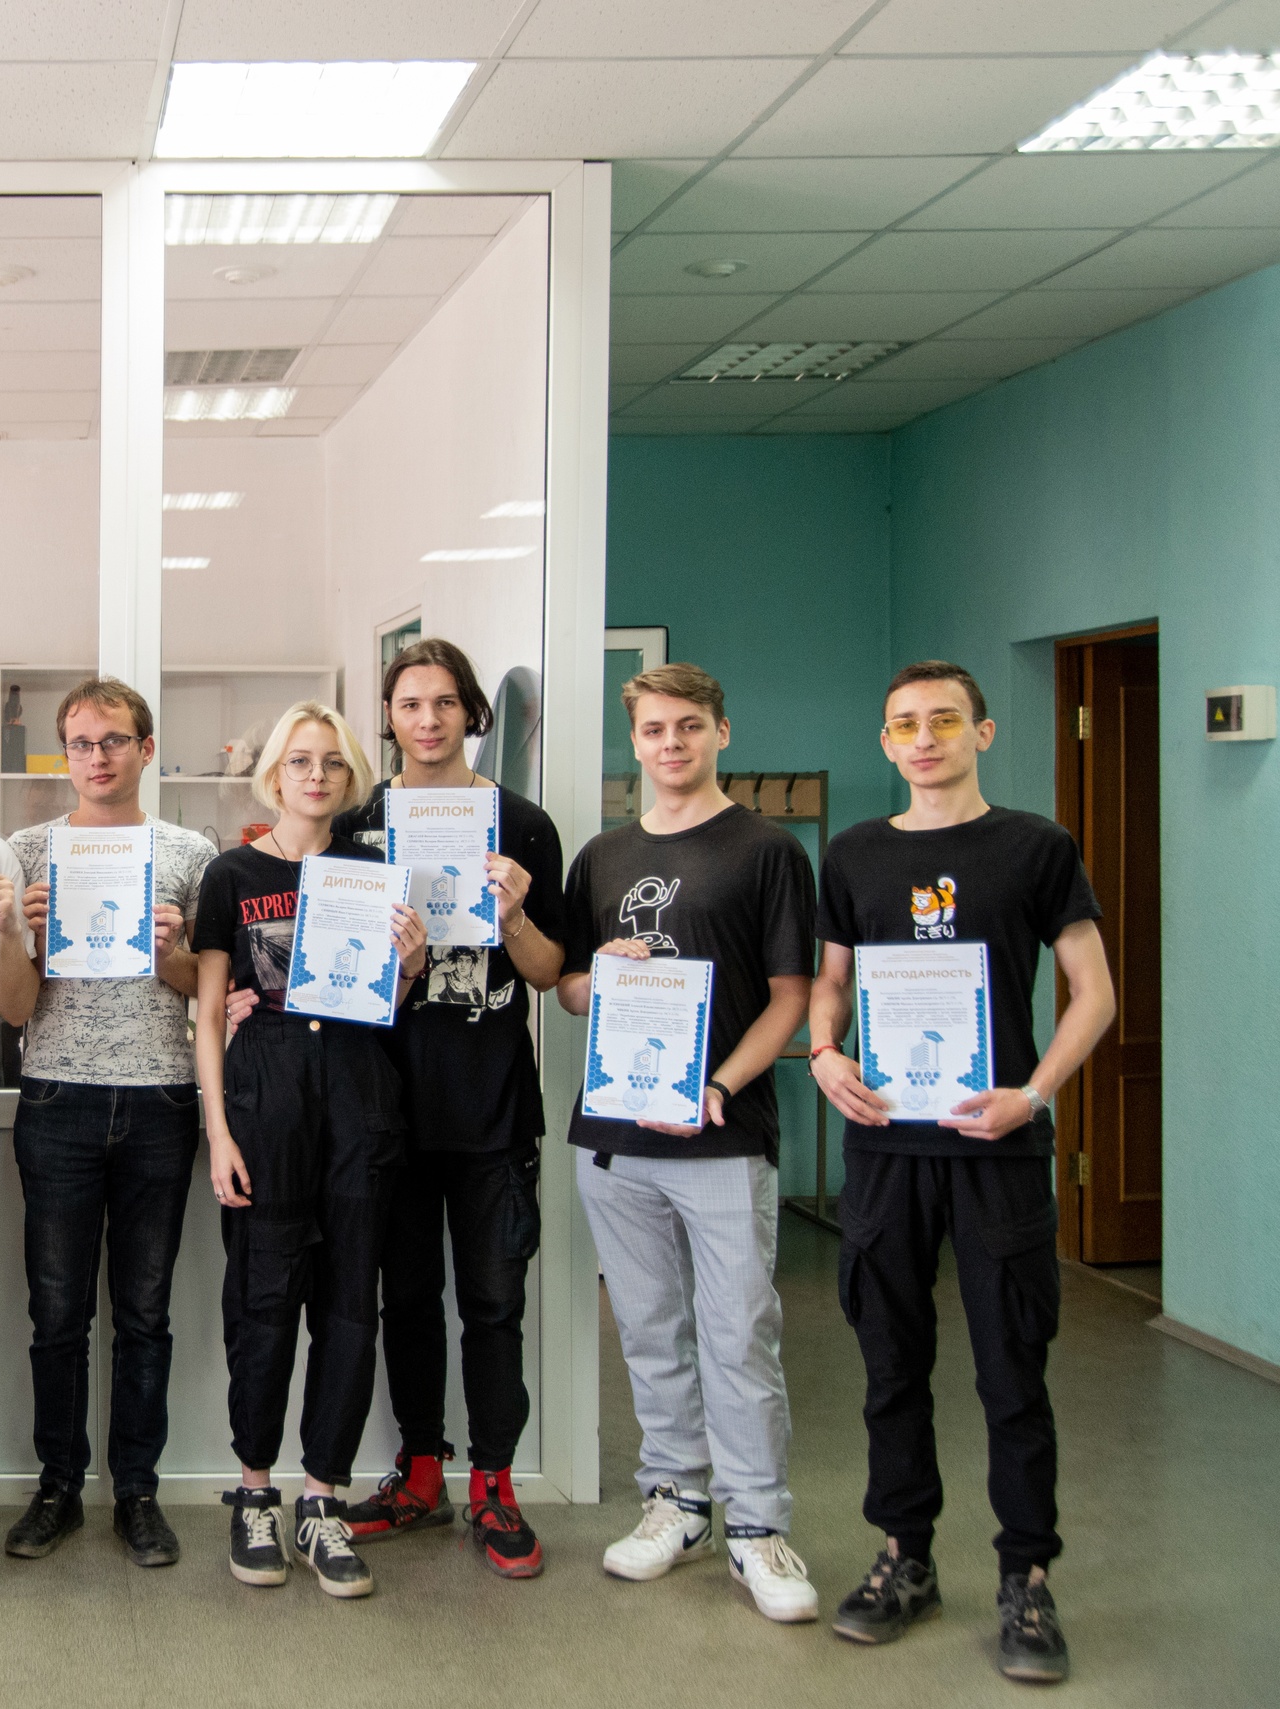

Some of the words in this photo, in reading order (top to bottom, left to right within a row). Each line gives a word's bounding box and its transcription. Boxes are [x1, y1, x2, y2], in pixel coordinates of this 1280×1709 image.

[409, 806, 474, 819] ДИПЛОМ
[70, 843, 133, 856] ДИПЛОМ
[322, 875, 386, 892] ДИПЛОМ
[914, 924, 955, 941] にぎり
[871, 969, 973, 980] БЛАГОДАРНОСТЬ
[616, 974, 685, 990] ДИПЛОМ
